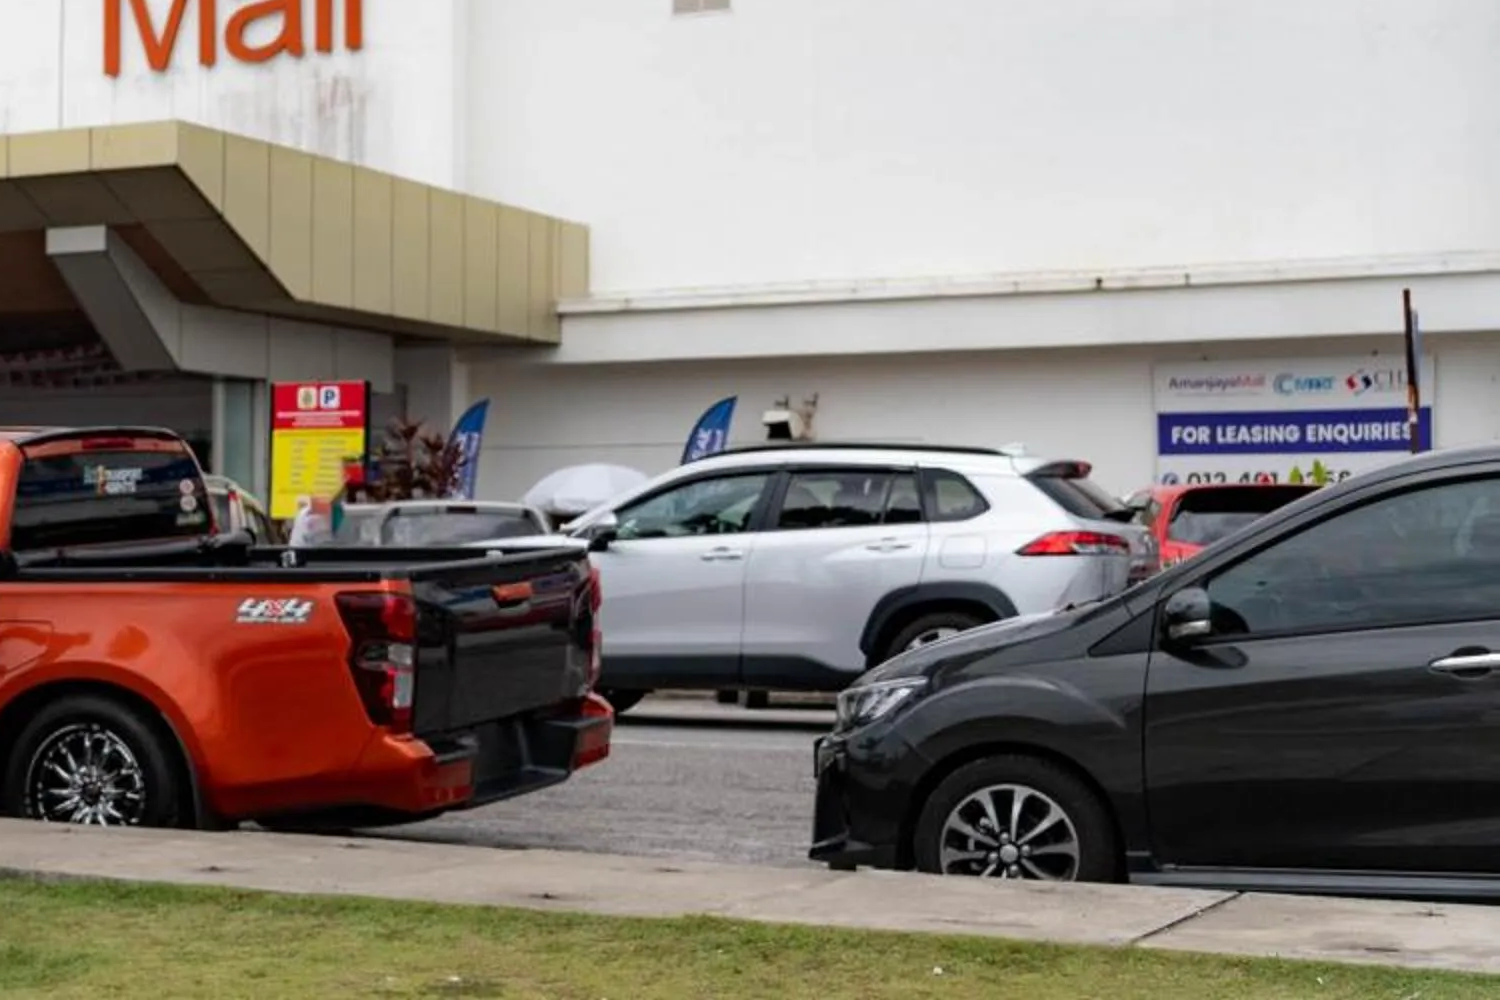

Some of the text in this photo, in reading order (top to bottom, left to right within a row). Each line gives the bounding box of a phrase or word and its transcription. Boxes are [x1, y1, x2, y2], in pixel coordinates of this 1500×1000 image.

[1171, 420, 1412, 445] FOR LEASING ENQUIRIES
